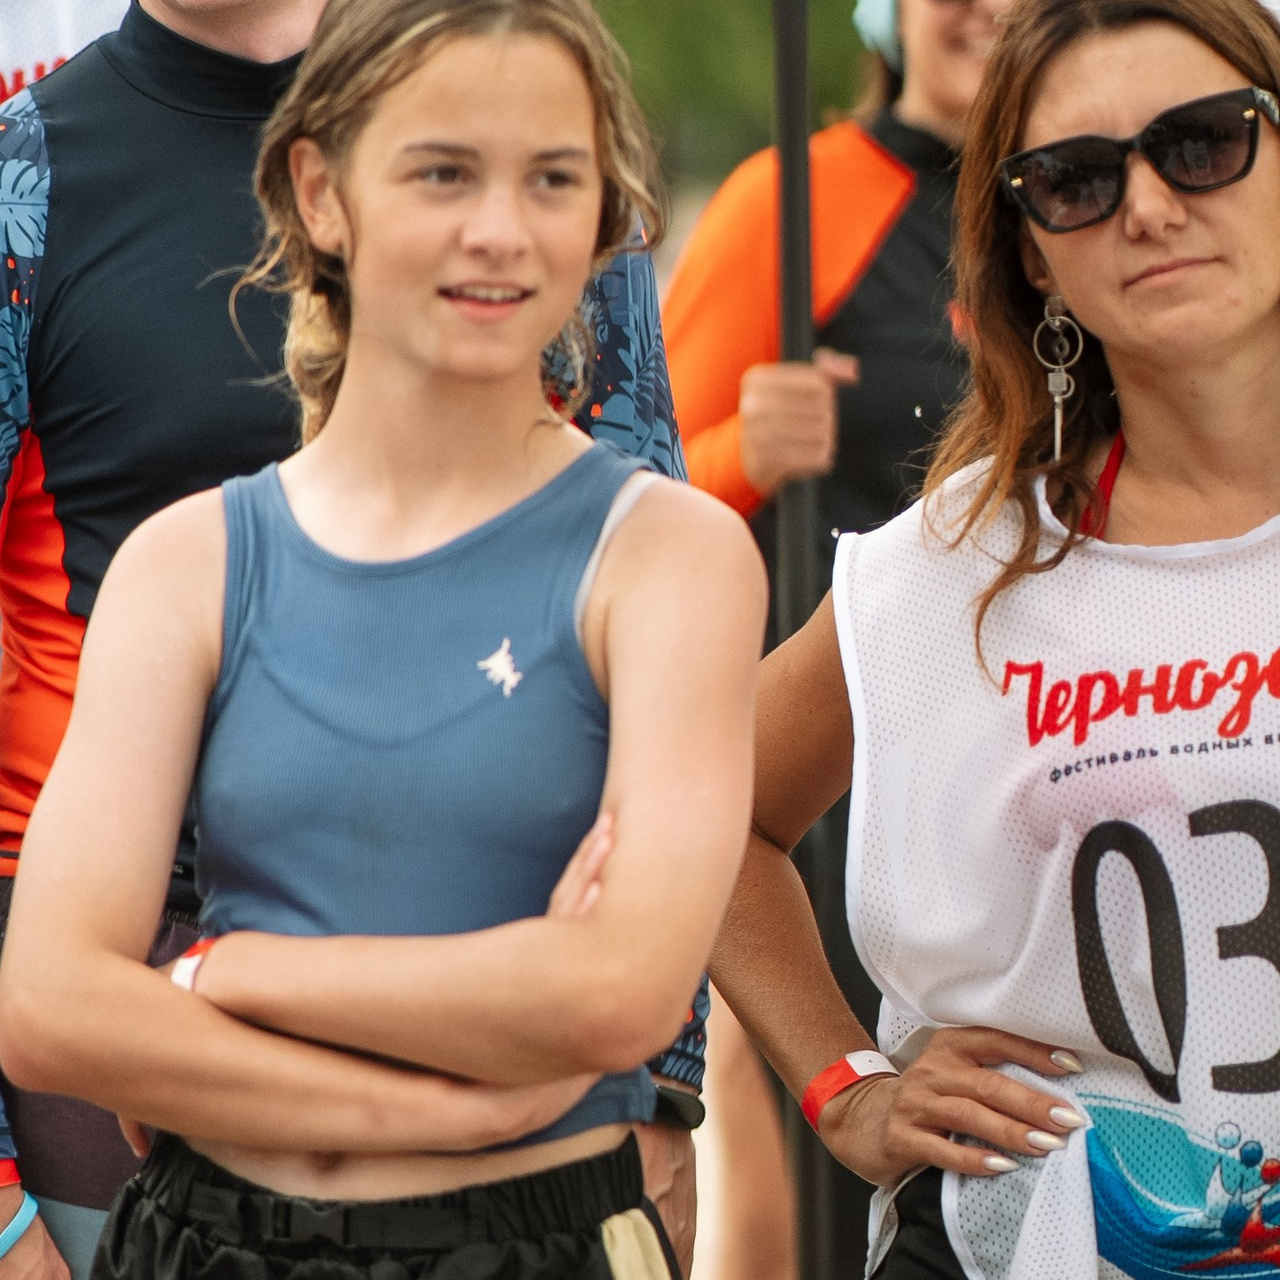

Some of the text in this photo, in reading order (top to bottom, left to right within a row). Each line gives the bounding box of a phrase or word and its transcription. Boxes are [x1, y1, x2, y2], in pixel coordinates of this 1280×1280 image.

[1049, 747, 1159, 783] фестиваль
[1169, 736, 1254, 755] водных
[1071, 798, 1280, 1104] 03
